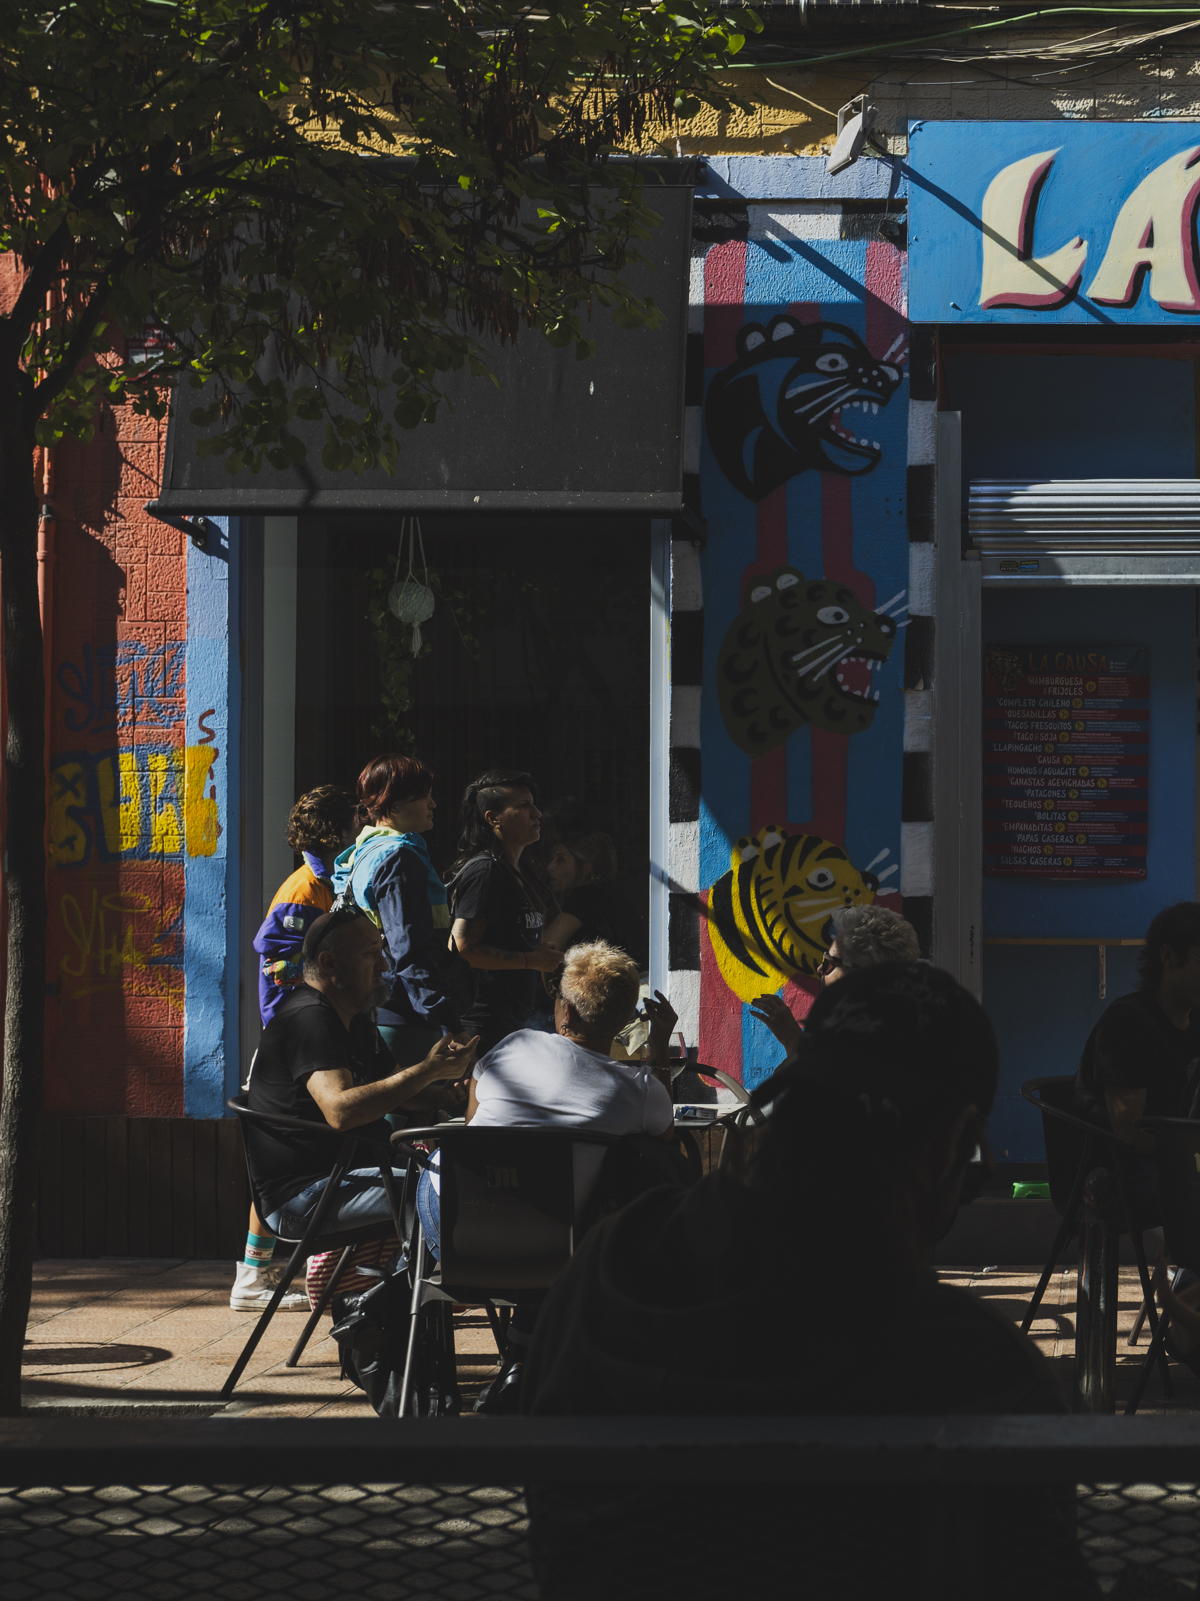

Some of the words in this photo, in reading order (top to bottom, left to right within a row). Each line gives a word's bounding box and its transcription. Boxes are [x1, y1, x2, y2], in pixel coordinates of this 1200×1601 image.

[1028, 652, 1049, 672] LA
[1054, 651, 1107, 673] CAUSA
[1029, 676, 1083, 686] HAMBURGUESA
[999, 697, 1036, 707] COMPLETO
[1007, 720, 1028, 730] TACOS
[1016, 732, 1034, 741] TACO
[1039, 733, 1058, 742] SOJA
[1037, 755, 1061, 764] CAUSA
[1007, 766, 1037, 775] HUMMUS
[1043, 767, 1077, 776] AGUACATE
[1010, 777, 1045, 787] CANASTAS
[1026, 789, 1066, 798] PATACONES
[1004, 799, 1042, 809] TEQUEÑOS
[1017, 833, 1039, 843] PAPAS
[1041, 834, 1074, 844] CASERAS
[1013, 845, 1042, 854] NACHOS
[1000, 856, 1027, 865] SALSAS
[1029, 857, 1062, 866] CASERAS
